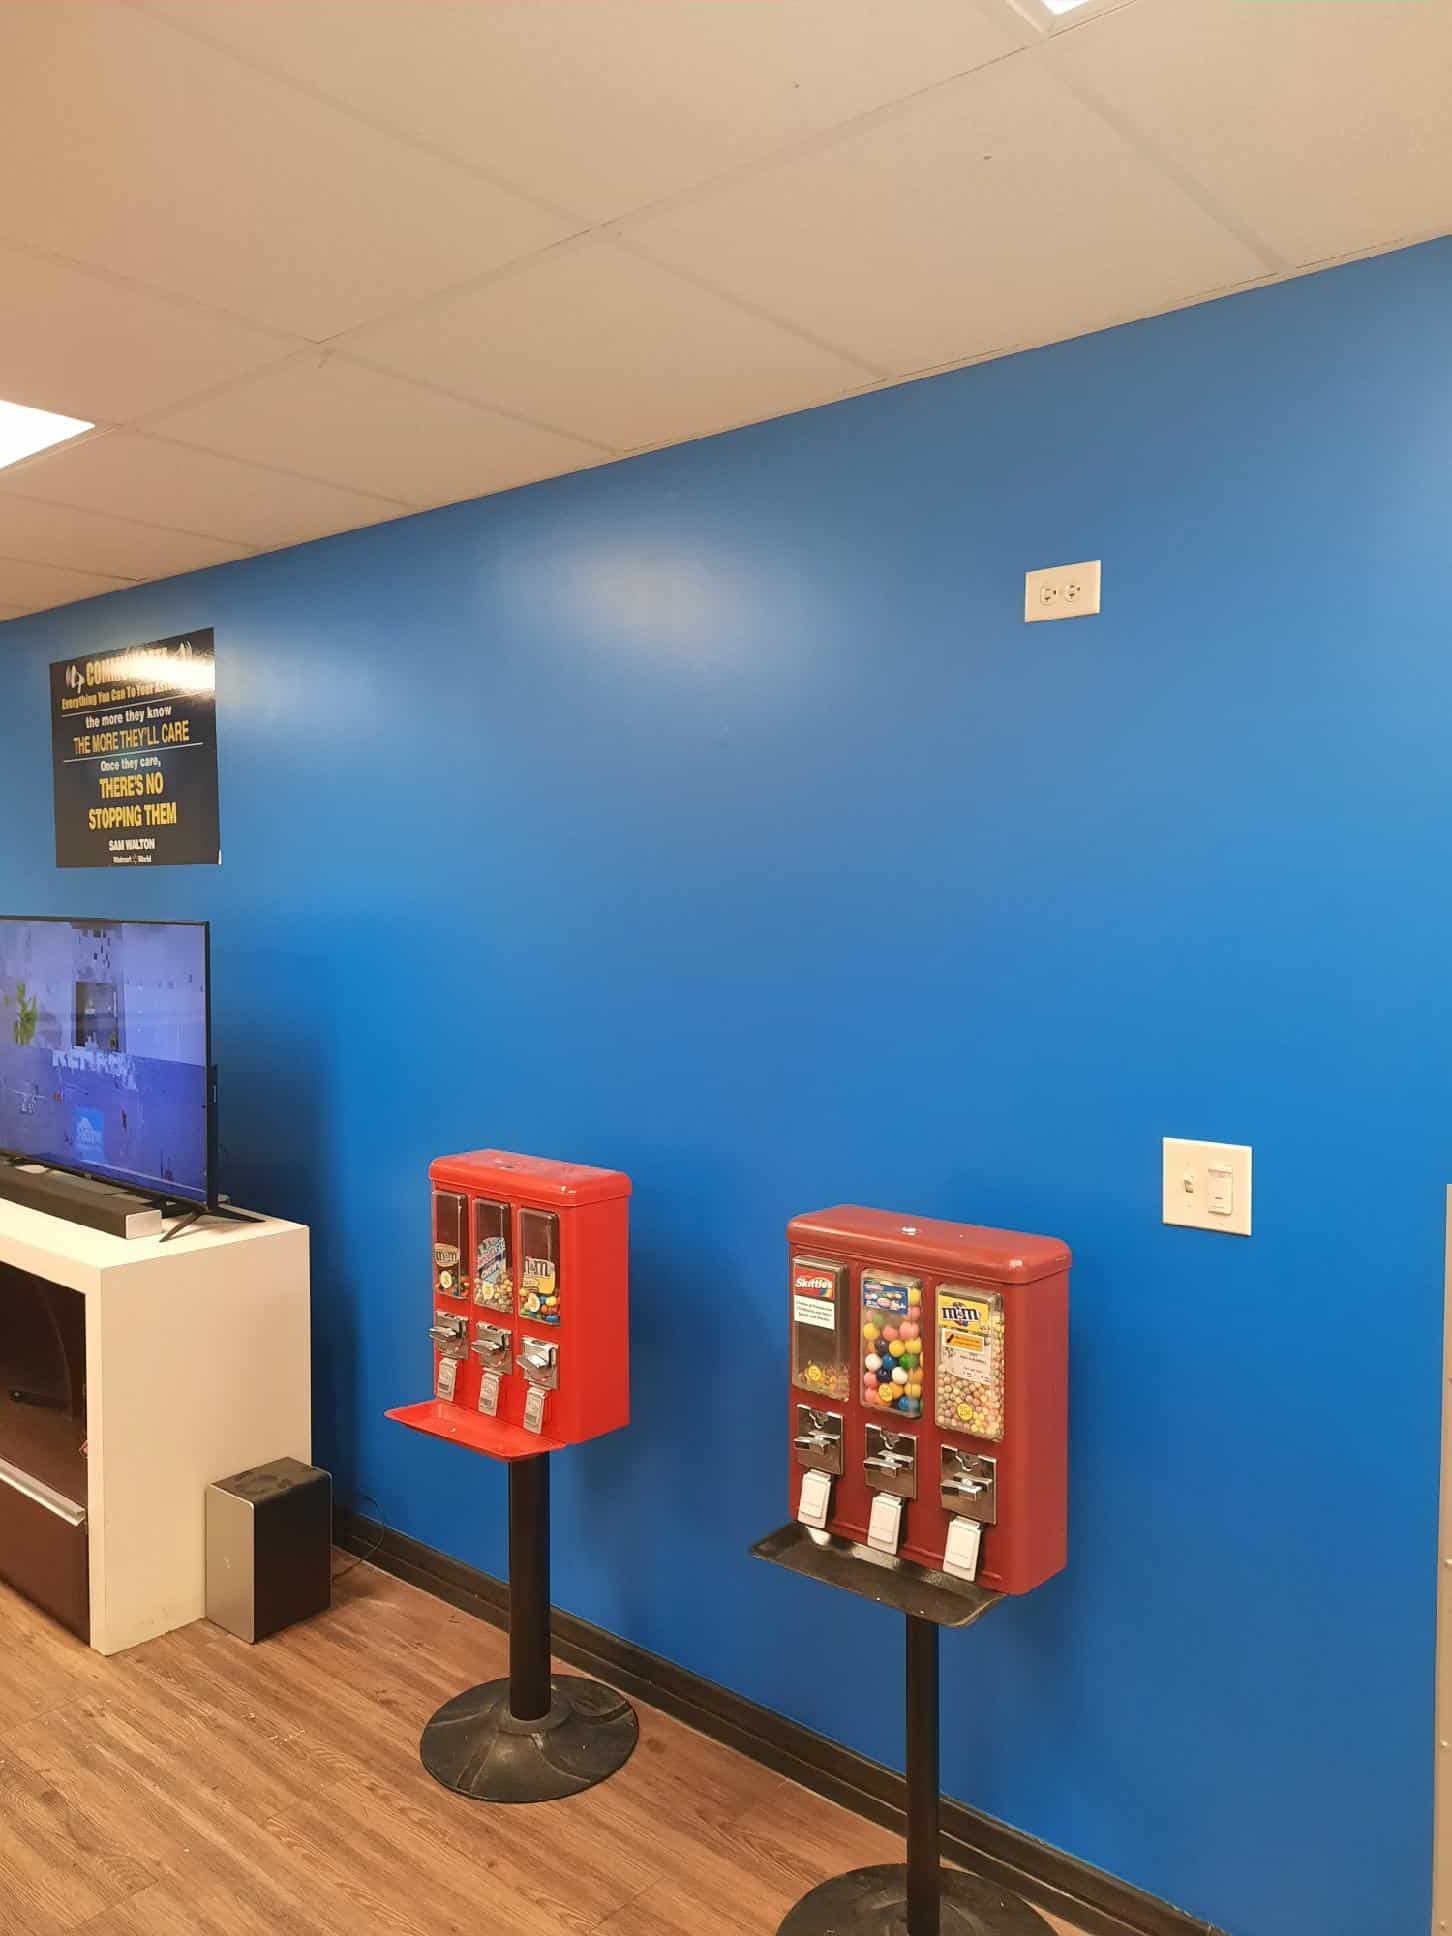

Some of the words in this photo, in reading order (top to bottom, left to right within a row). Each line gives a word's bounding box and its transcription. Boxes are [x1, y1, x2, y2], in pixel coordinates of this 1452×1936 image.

[86, 717, 100, 729] the
[102, 715, 124, 727] more
[125, 710, 144, 723] they
[147, 705, 172, 719] know
[73, 736, 91, 755] THE
[92, 731, 119, 751] MORE
[119, 726, 160, 748] THEY'LL
[161, 720, 190, 743] CARE
[100, 761, 120, 772] Once
[122, 759, 138, 770] they
[140, 756, 161, 768] care,
[99, 774, 144, 799] THERE'S
[146, 771, 164, 795] NO
[88, 804, 143, 830] STOPPING
[144, 801, 177, 826] THEM
[108, 839, 125, 851] SAM
[126, 838, 155, 850] WALTON
